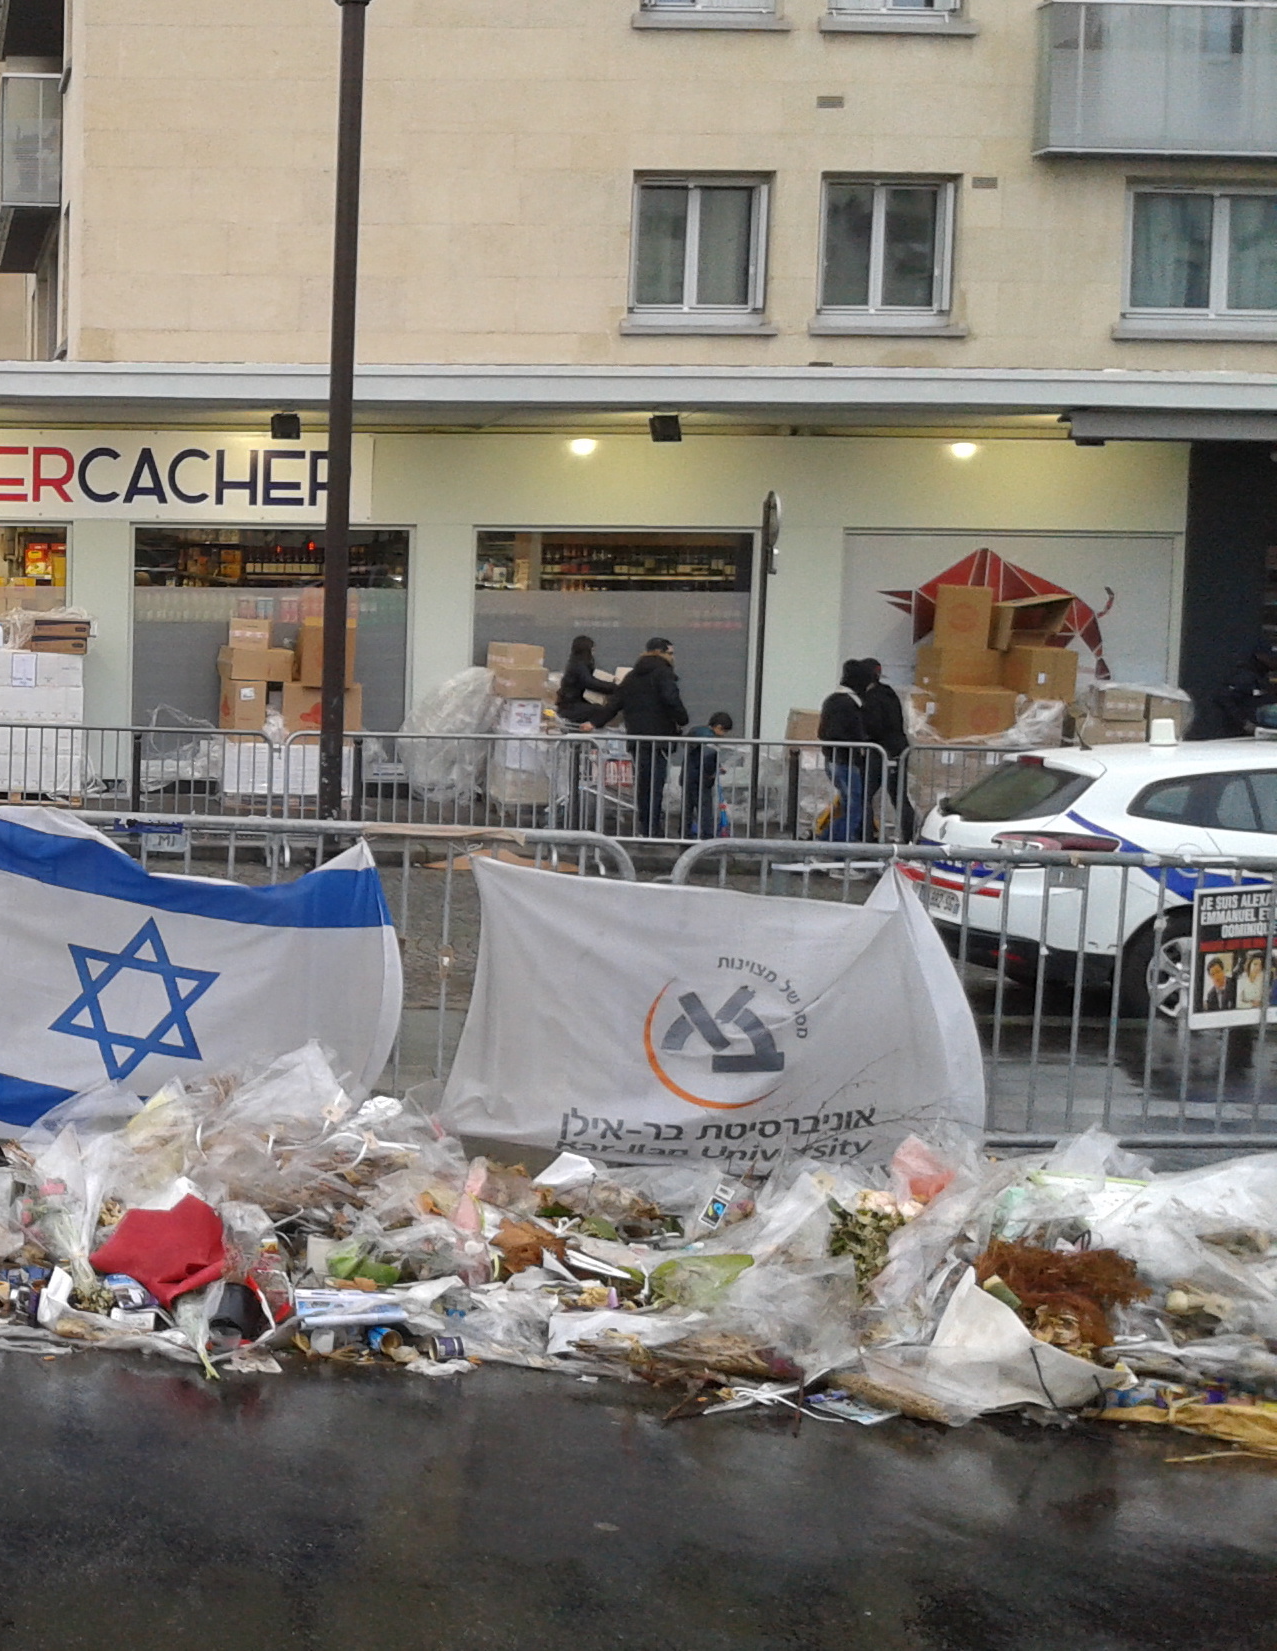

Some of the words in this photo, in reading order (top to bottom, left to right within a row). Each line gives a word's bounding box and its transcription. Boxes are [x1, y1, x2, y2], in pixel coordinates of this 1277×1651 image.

[1200, 896, 1214, 910] JE
[1215, 894, 1238, 909] SUIS
[1240, 892, 1271, 908] ALEX
[1200, 908, 1256, 926] EMMANUEL
[1221, 921, 1277, 939] DOMINIQ
[794, 1009, 809, 1039] מס
[695, 1107, 876, 1140] אוניברסיטת
[701, 1137, 874, 1162] Univrsity
